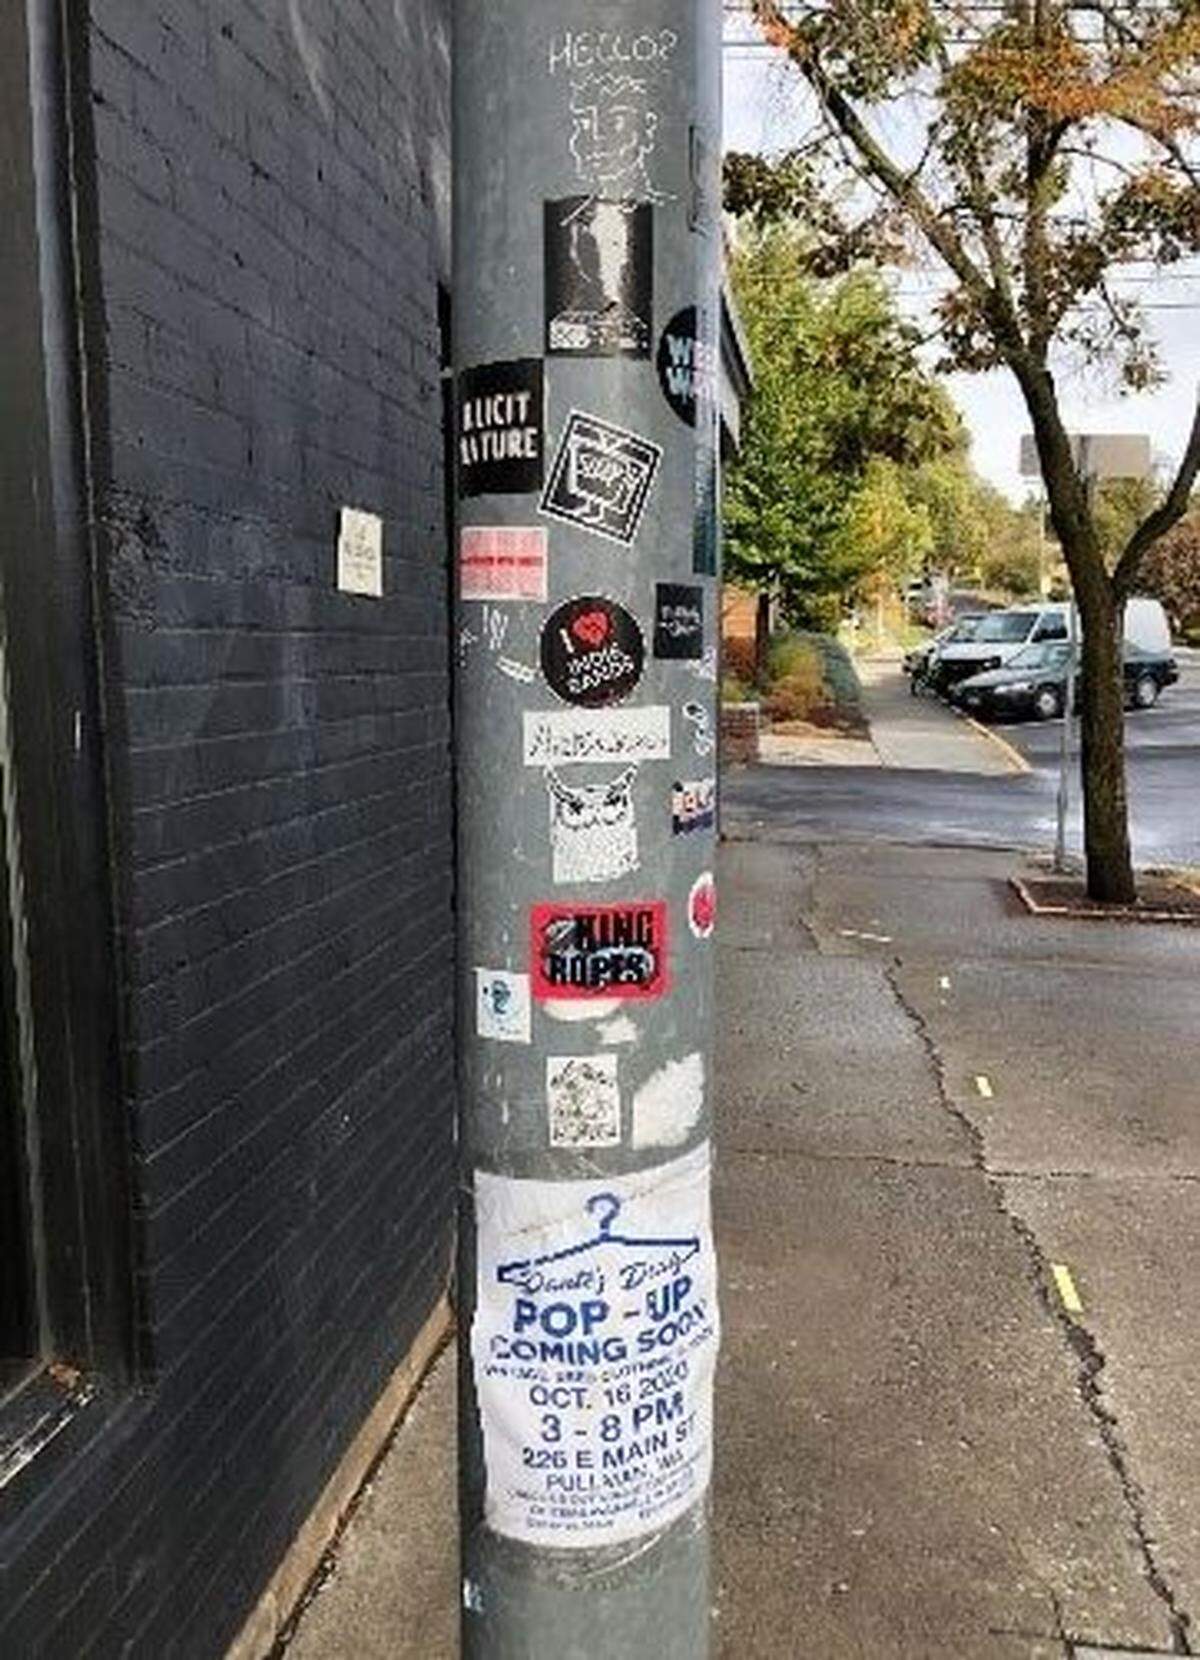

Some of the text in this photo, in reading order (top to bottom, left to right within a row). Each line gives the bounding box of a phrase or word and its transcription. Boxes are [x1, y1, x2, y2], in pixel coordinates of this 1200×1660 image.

[577, 910, 654, 947] KING
[513, 1298, 611, 1338] POP
[646, 1275, 692, 1322] UP
[490, 1335, 628, 1366] COMING
[529, 1385, 593, 1410] OCT.
[541, 1413, 562, 1443] 3
[600, 1414, 622, 1443] 8
[633, 1391, 684, 1434] PM
[522, 1446, 568, 1470] 226
[576, 1450, 595, 1469] E
[602, 1430, 668, 1470] MAIN
